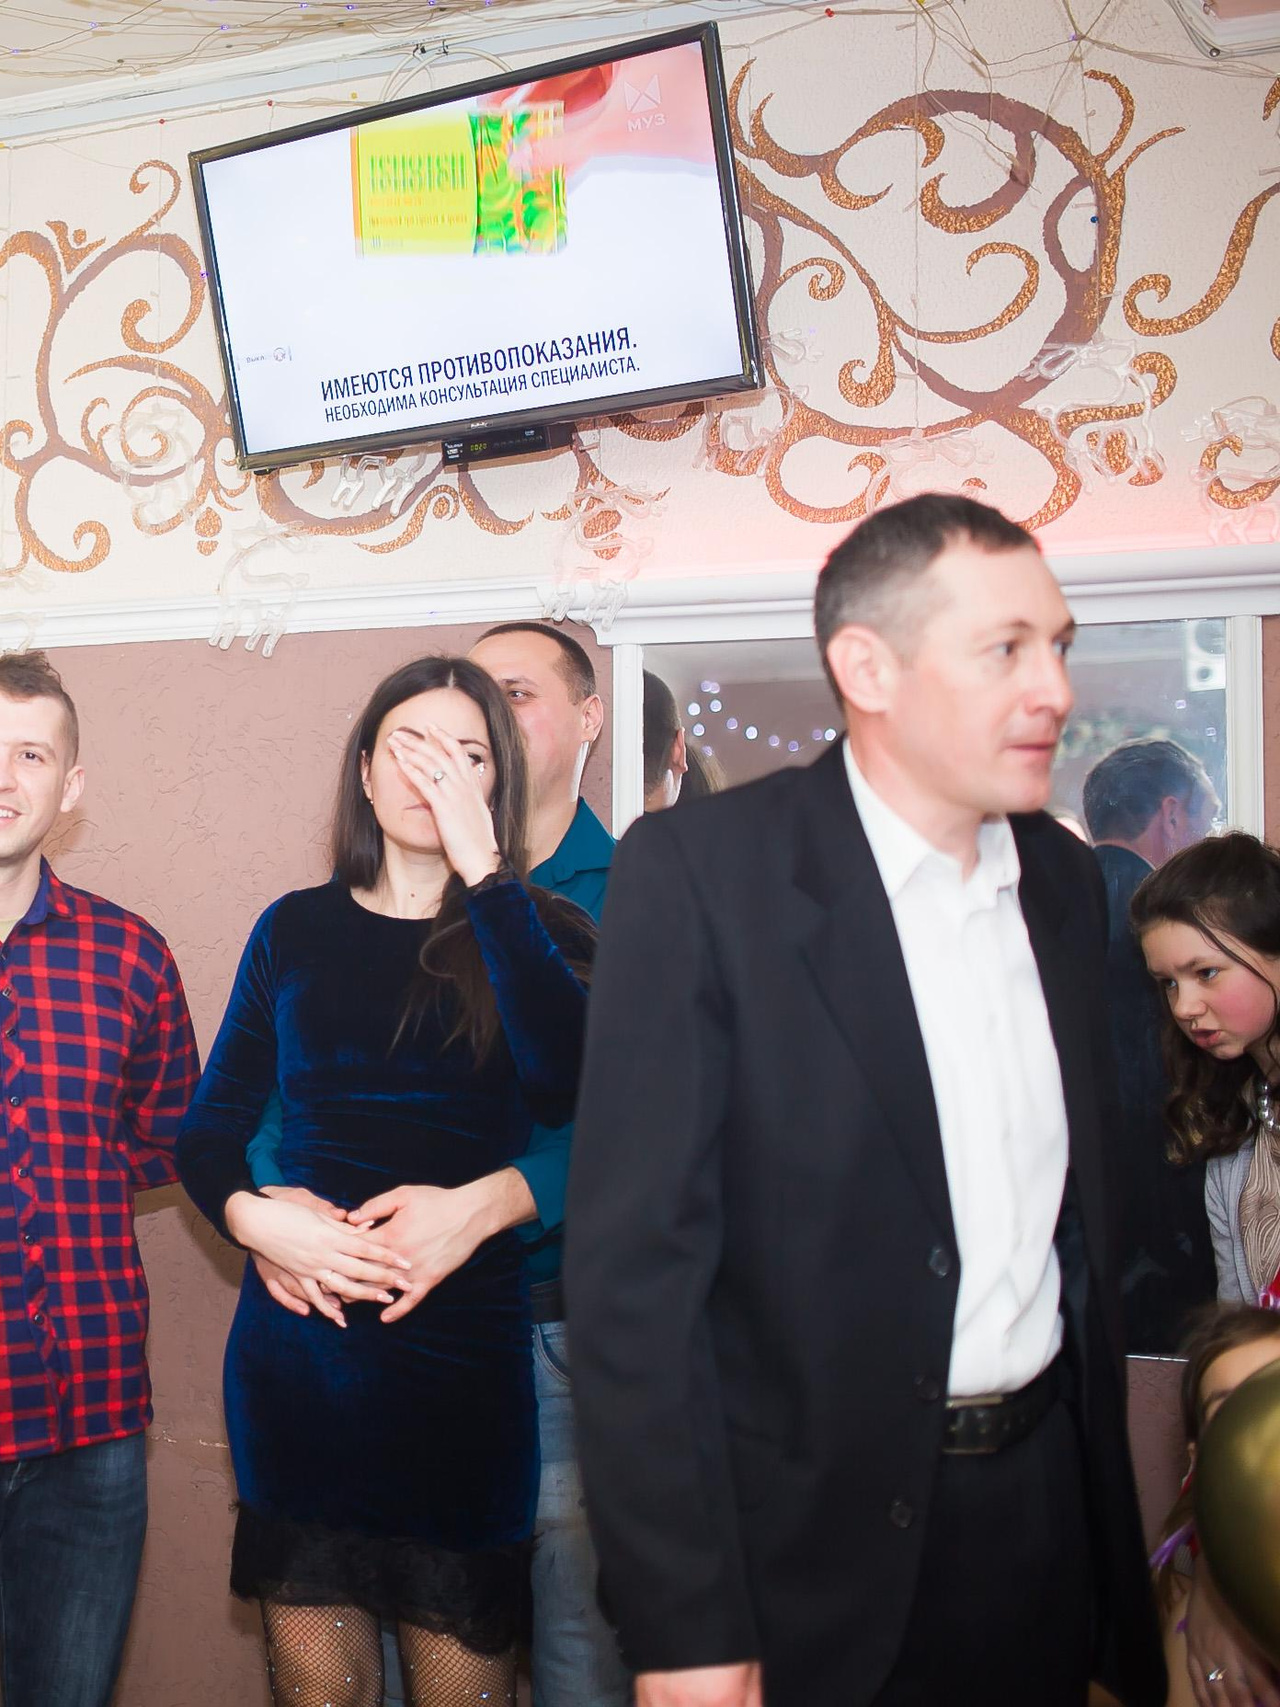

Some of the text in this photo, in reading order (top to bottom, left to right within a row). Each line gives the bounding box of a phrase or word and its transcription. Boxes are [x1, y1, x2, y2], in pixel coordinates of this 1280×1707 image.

[627, 113, 665, 132] МУЗ
[321, 327, 637, 401] ИМЕЮТСЯ ПРОТИВОПОКАЗАНИЯ.
[325, 356, 640, 423] НЕОБХОДИМА КОНСУЛЬТАЦИЯ СПЕЦИАЛИСТА.
